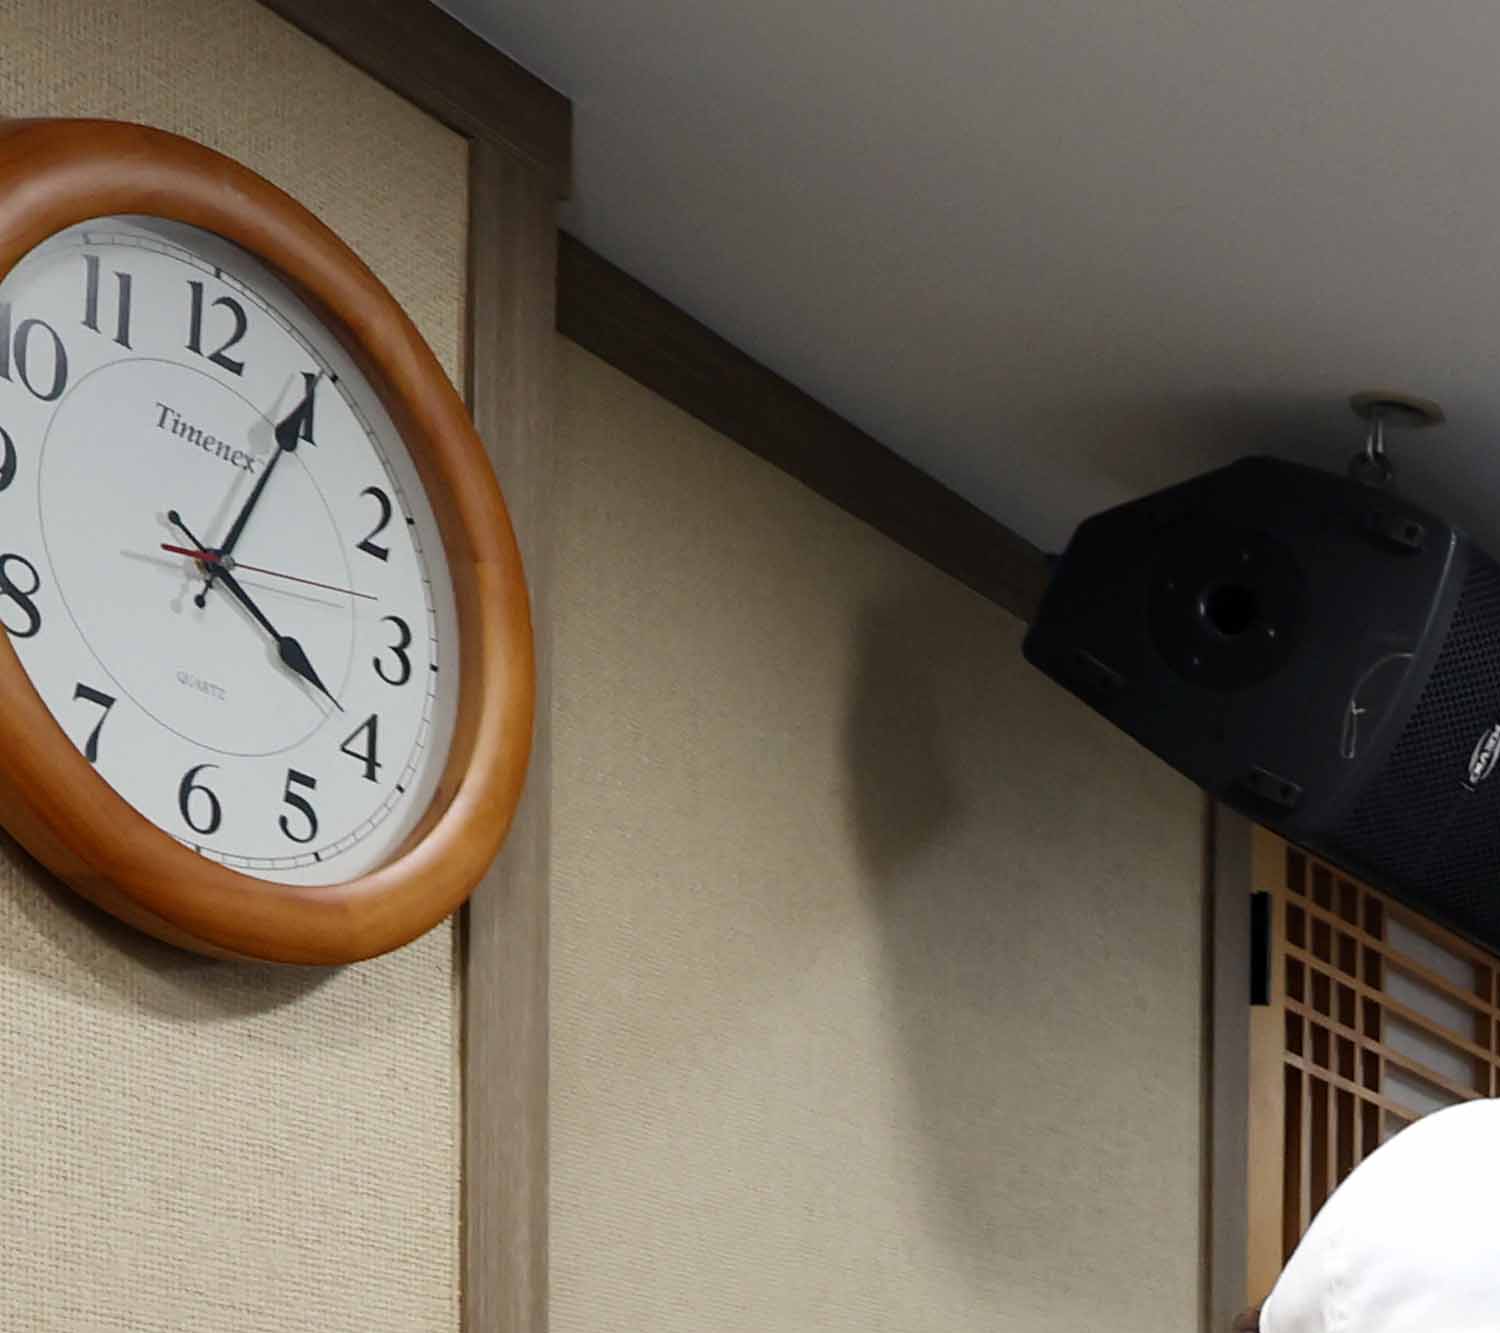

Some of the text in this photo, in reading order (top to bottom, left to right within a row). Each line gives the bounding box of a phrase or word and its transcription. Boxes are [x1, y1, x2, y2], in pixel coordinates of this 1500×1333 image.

[82, 254, 133, 351] 11
[185, 280, 247, 376] 12
[155, 402, 257, 474] Timenex
[355, 486, 392, 562] 2
[372, 615, 412, 686] 3
[73, 683, 116, 763] 7
[339, 713, 382, 784] 4
[178, 764, 221, 835] 6
[279, 768, 319, 844] 5
